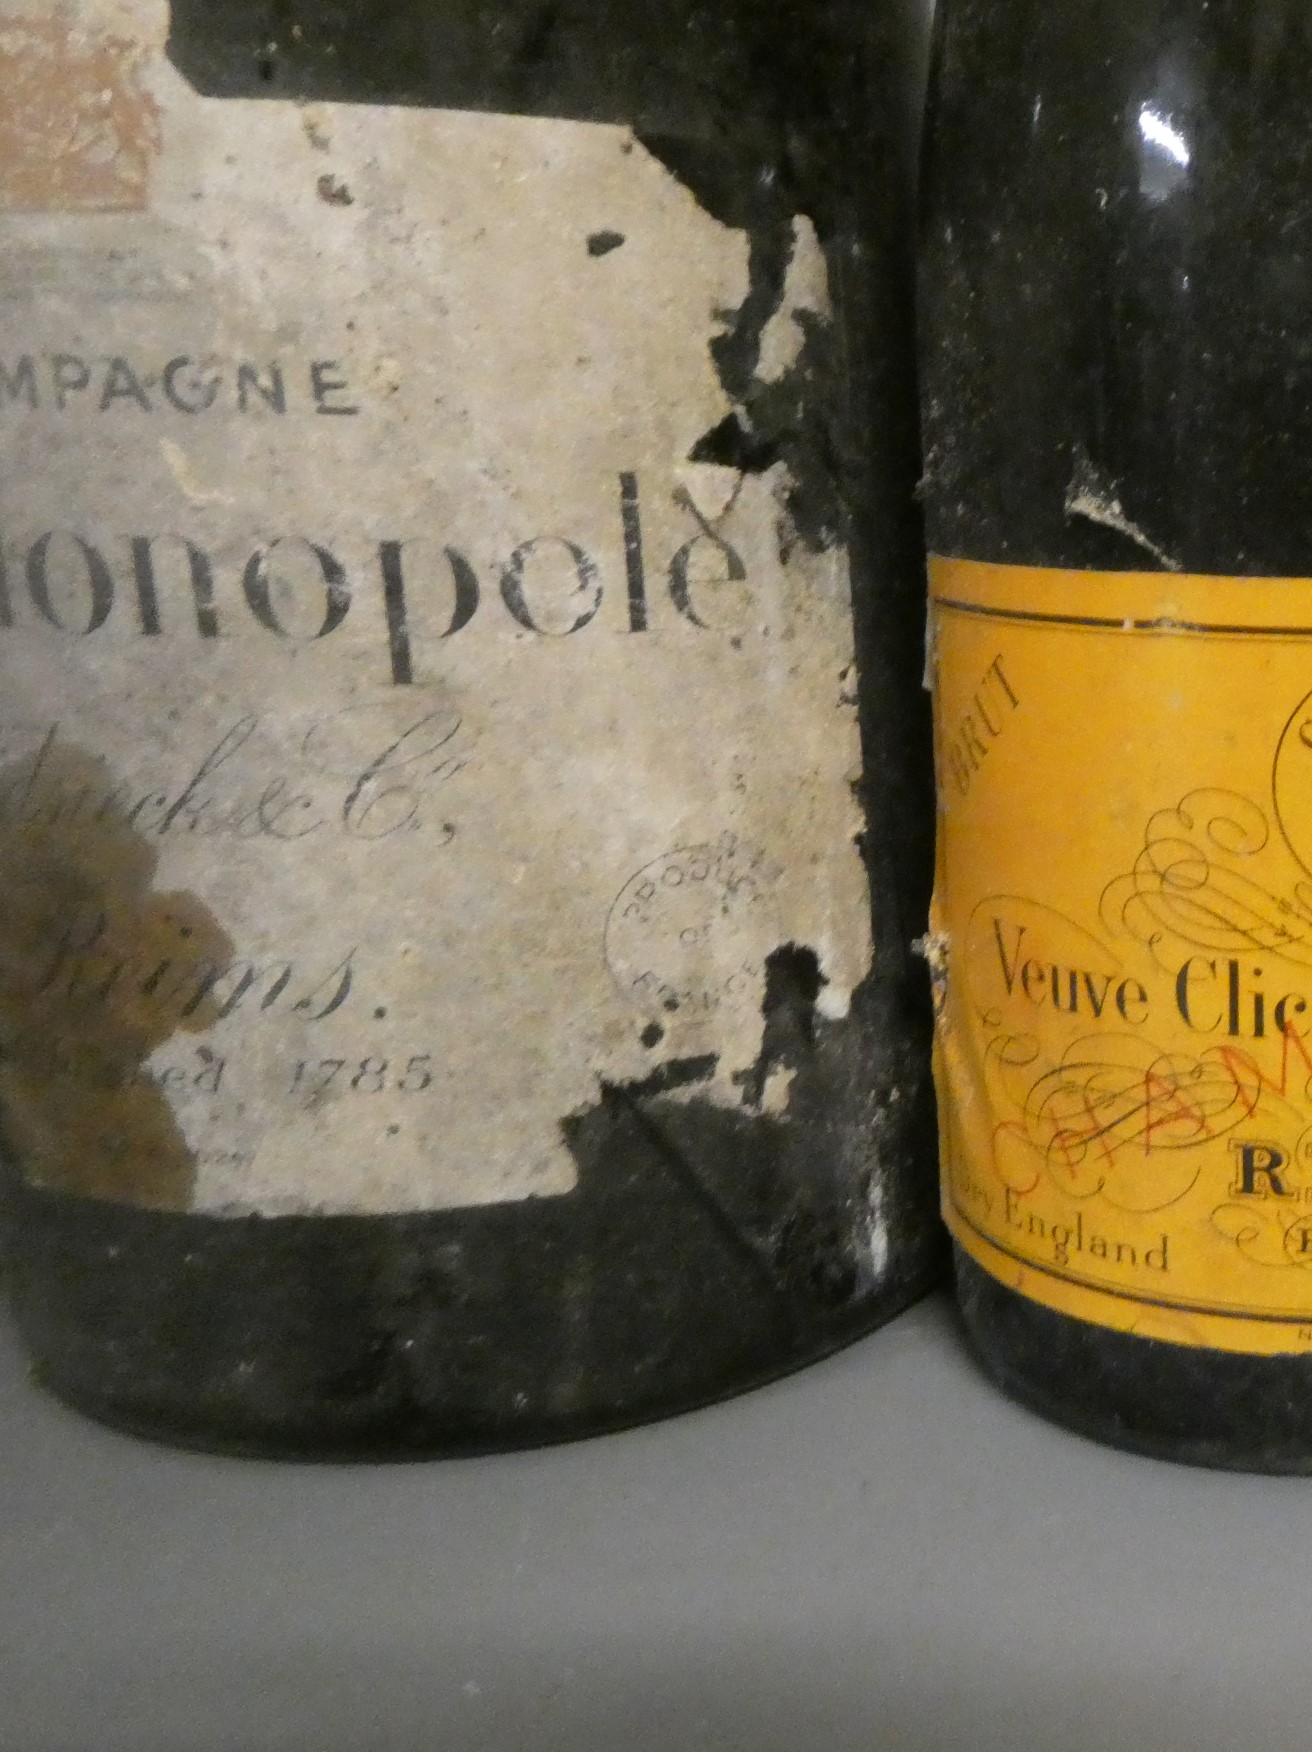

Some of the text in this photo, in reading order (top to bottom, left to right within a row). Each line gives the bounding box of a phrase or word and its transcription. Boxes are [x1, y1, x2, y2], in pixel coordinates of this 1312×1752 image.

[0, 472, 747, 686] onopole
[993, 916, 1150, 1027] Veuve
[291, 1053, 434, 1101] 1785
[1003, 1183, 1170, 1274] England
